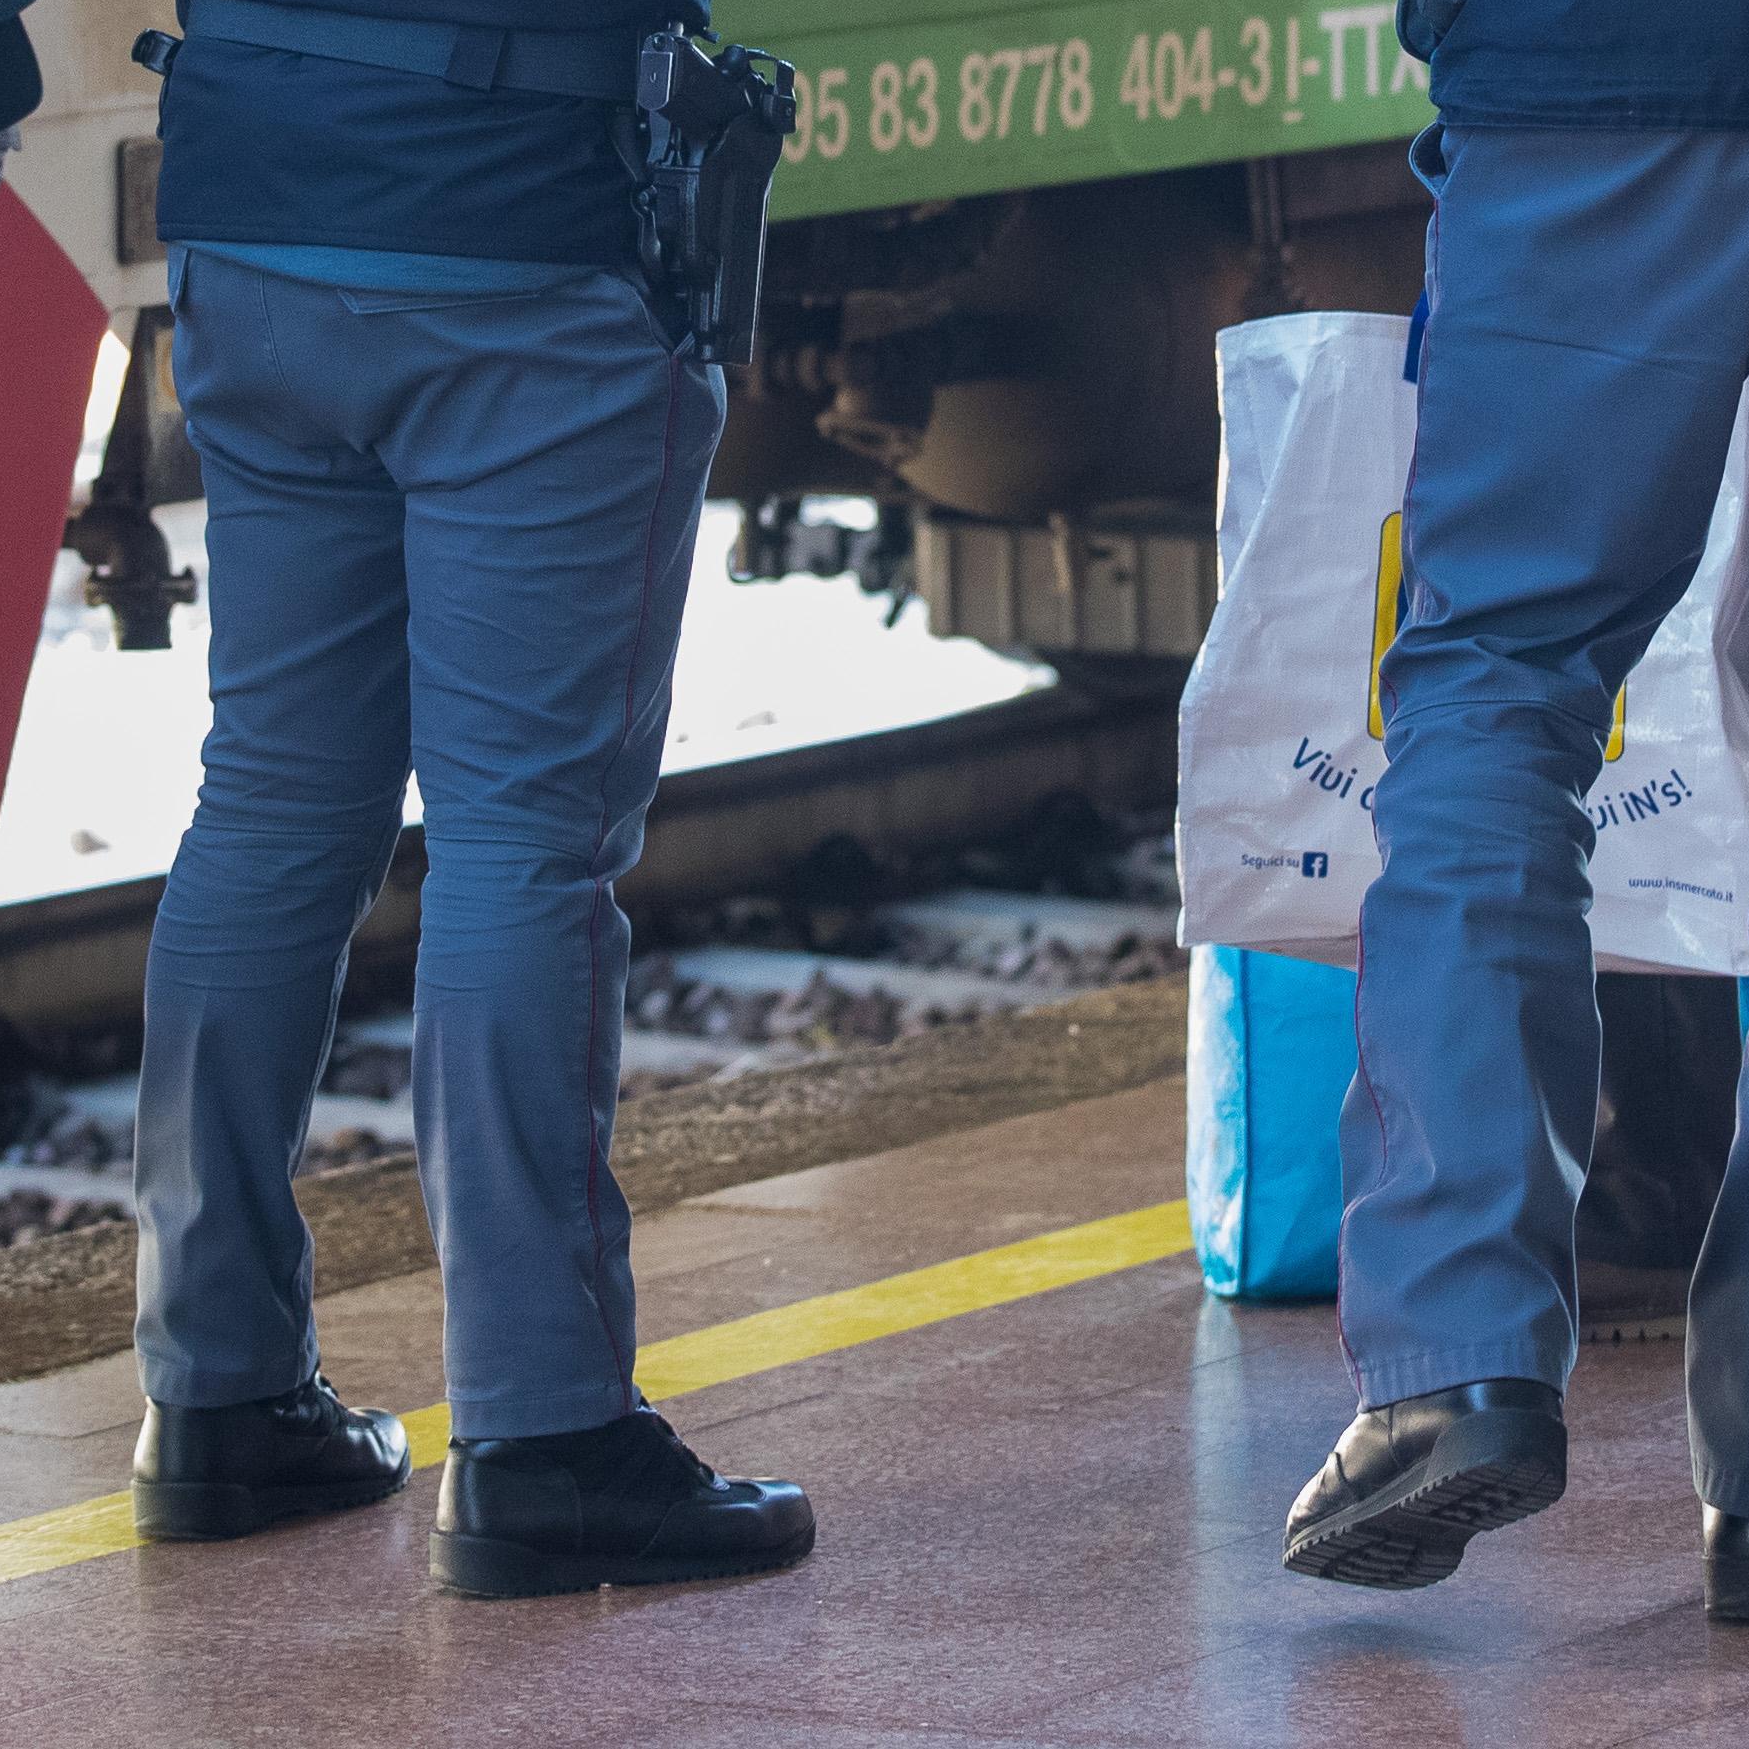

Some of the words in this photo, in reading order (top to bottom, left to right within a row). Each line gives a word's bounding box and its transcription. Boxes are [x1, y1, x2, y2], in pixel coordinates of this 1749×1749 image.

[869, 57, 940, 151] 83
[958, 38, 1094, 141] 8778
[1241, 854, 1285, 870] Seguici
[1286, 857, 1300, 869] su
[1628, 876, 1734, 903] www.insmercato.it
